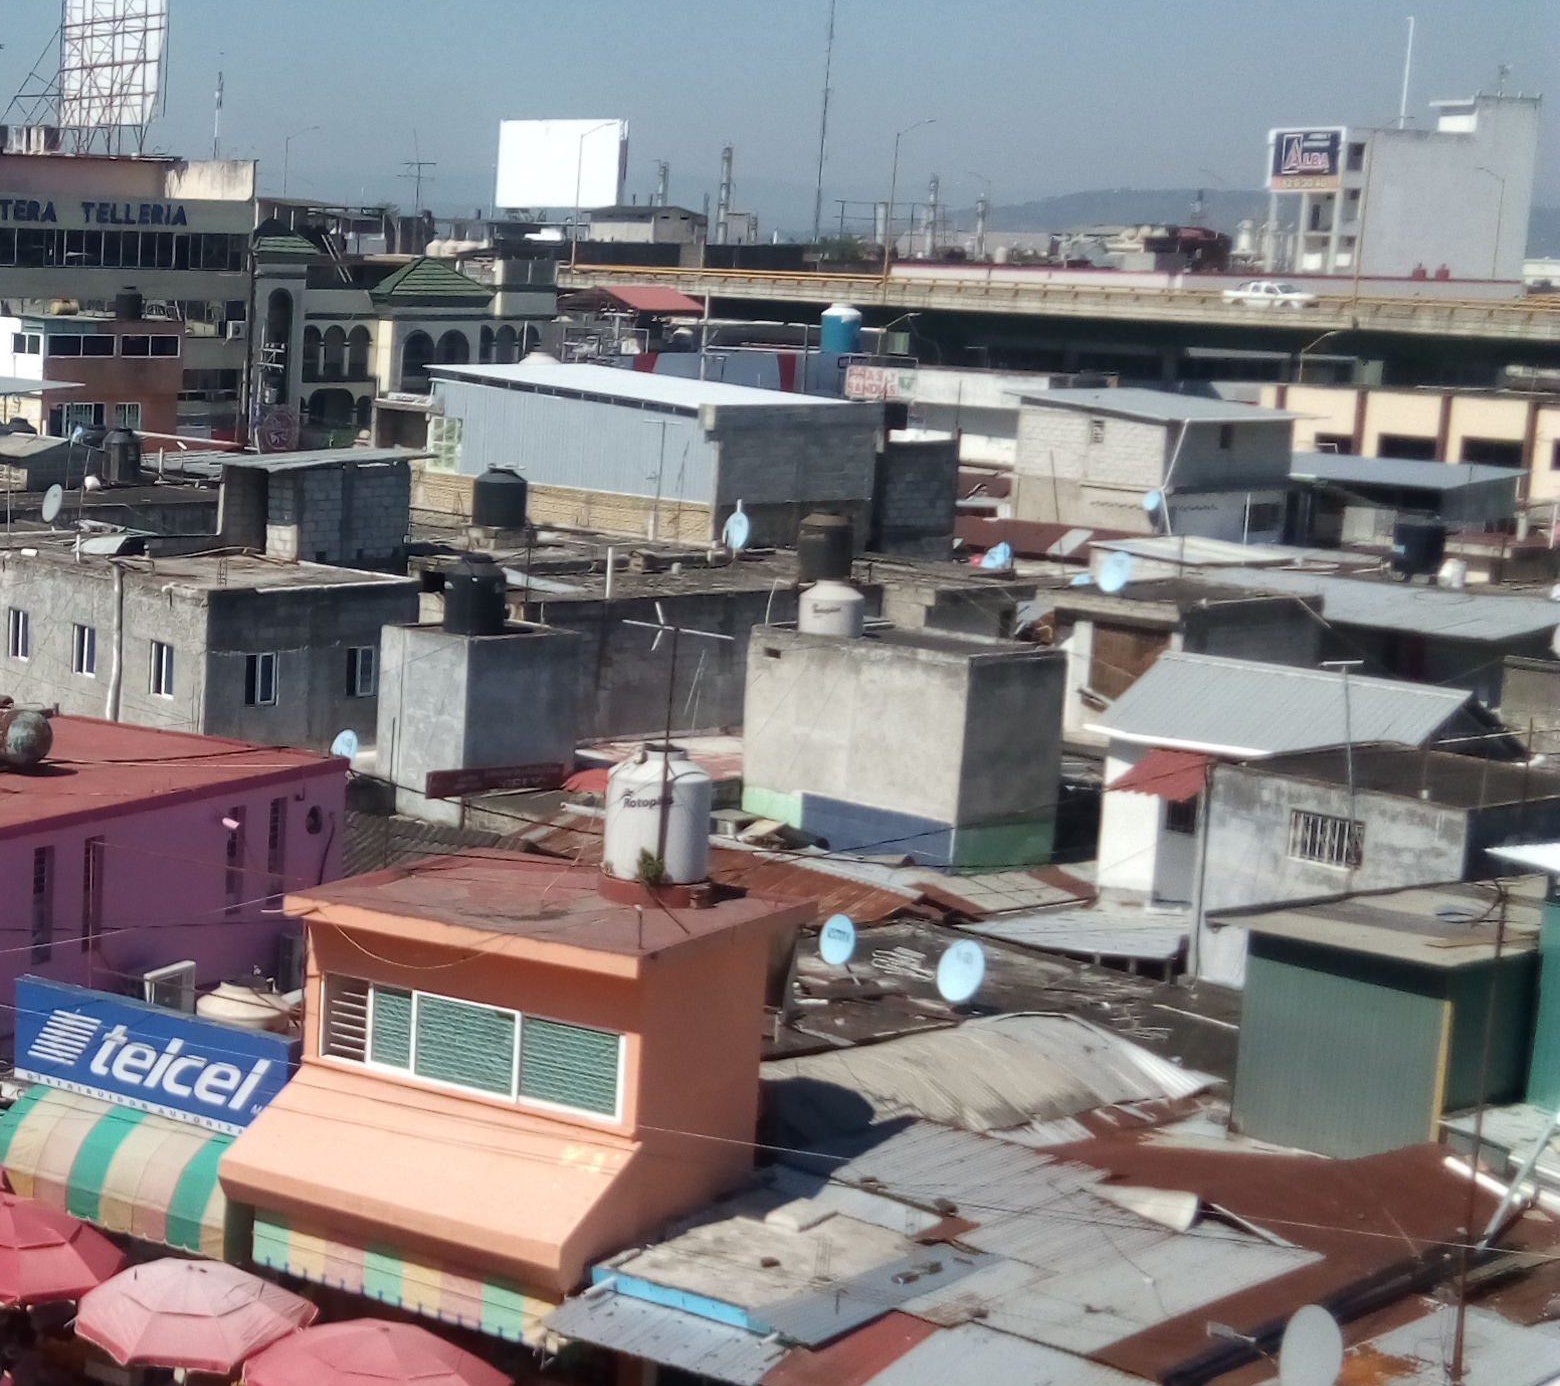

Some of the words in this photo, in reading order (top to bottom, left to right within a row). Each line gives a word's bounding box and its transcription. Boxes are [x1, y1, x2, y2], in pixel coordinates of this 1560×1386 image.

[1284, 137, 1330, 171] ALBA
[81, 200, 188, 227] TELLERIA
[624, 795, 673, 809] Rotopls
[90, 1024, 272, 1110] telcel
[26, 1072, 148, 1110] DISTRIBUIDOR
